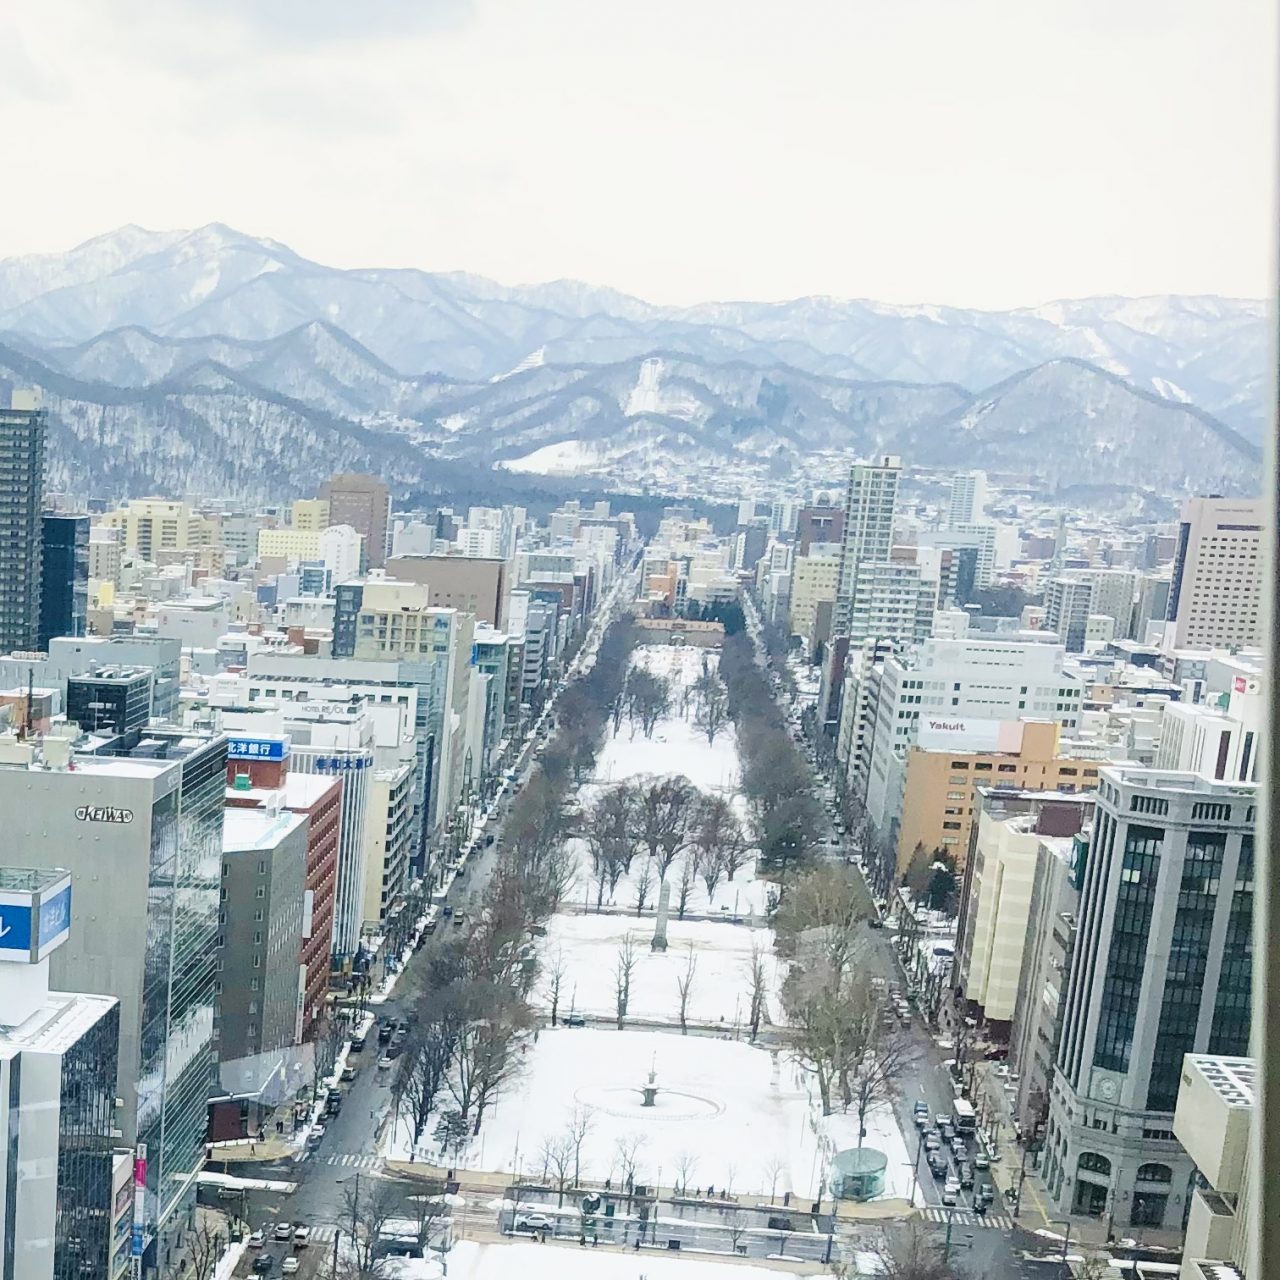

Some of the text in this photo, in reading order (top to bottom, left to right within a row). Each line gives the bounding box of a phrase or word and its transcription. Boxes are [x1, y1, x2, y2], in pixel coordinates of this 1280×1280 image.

[929, 721, 966, 731] Yakult
[228, 741, 271, 755] 北洋銀行
